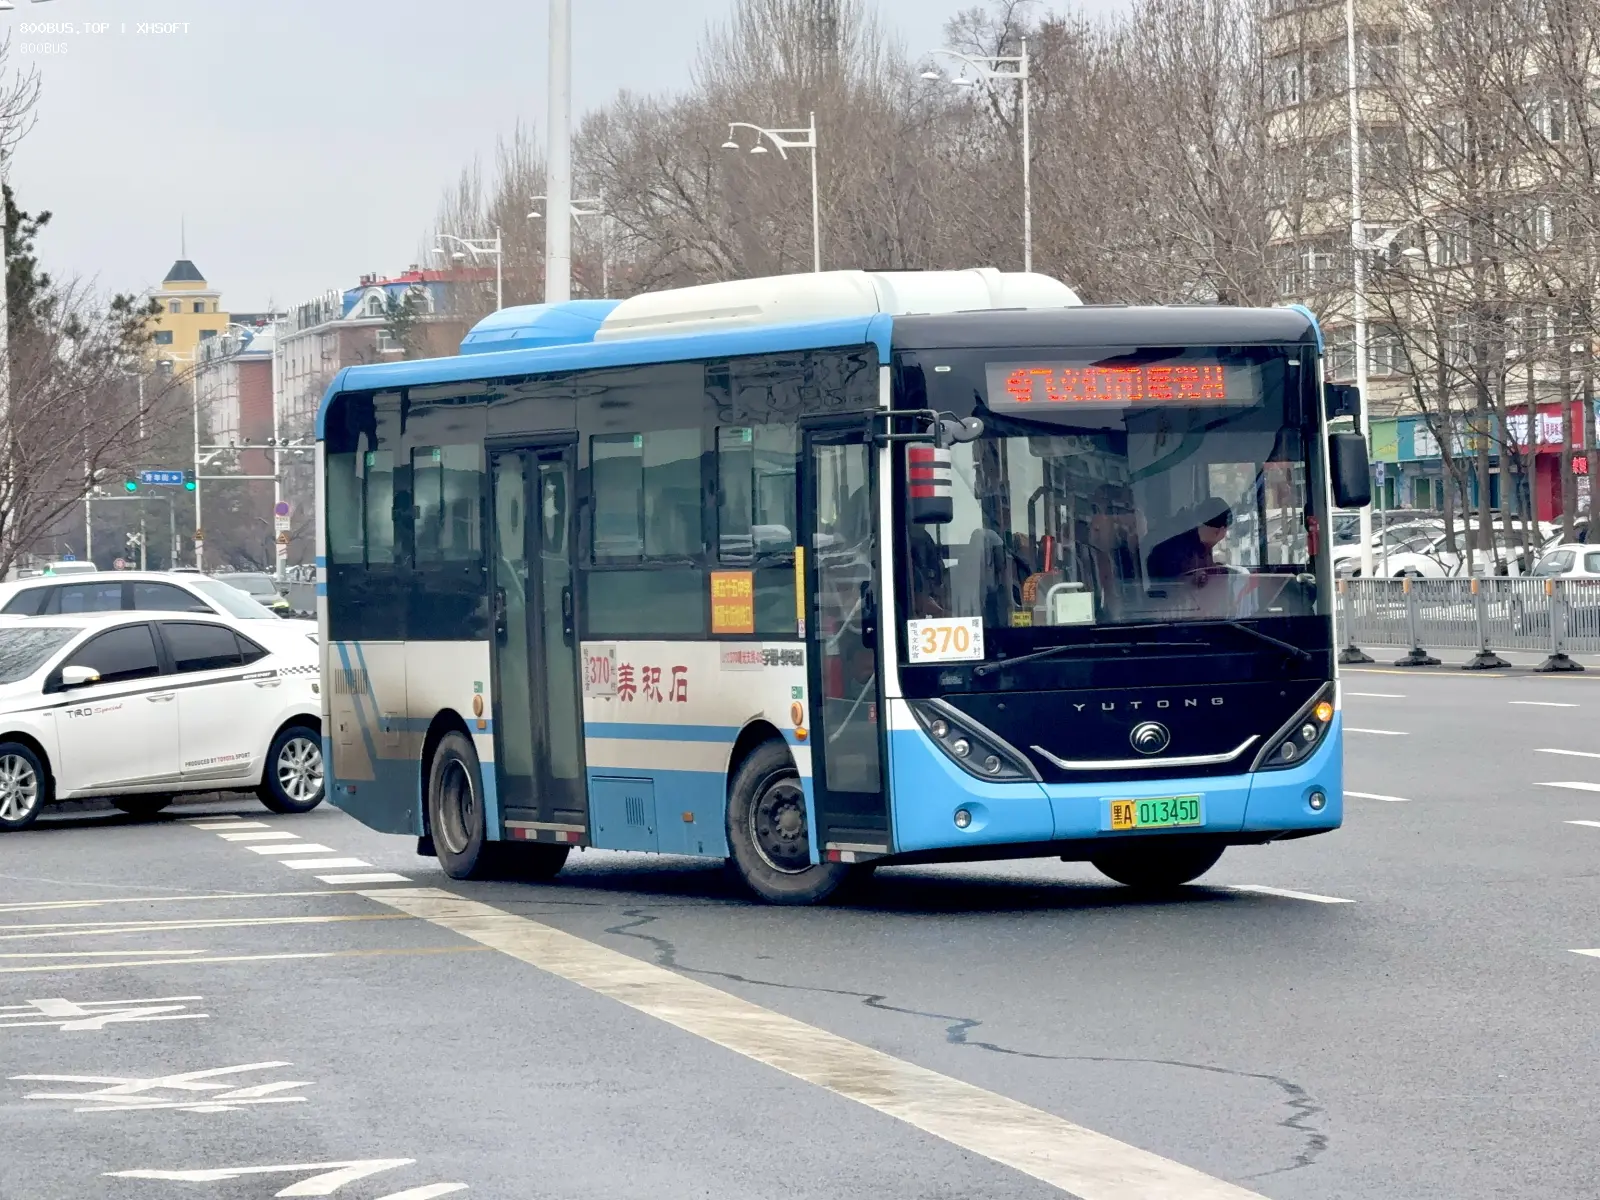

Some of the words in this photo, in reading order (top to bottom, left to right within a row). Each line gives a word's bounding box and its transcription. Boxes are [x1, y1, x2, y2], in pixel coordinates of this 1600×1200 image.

[910, 621, 920, 659] 哈飞文化宫
[921, 625, 970, 654] 370
[590, 656, 610, 684] 370
[65, 707, 92, 718] TRD
[1072, 697, 1224, 712] YUTONG
[184, 758, 210, 767] PRODUCED
[217, 754, 235, 763] TOYOTA
[235, 751, 251, 760] SPORT
[1113, 804, 1133, 825] 黑A
[1140, 799, 1198, 824] 01345D
